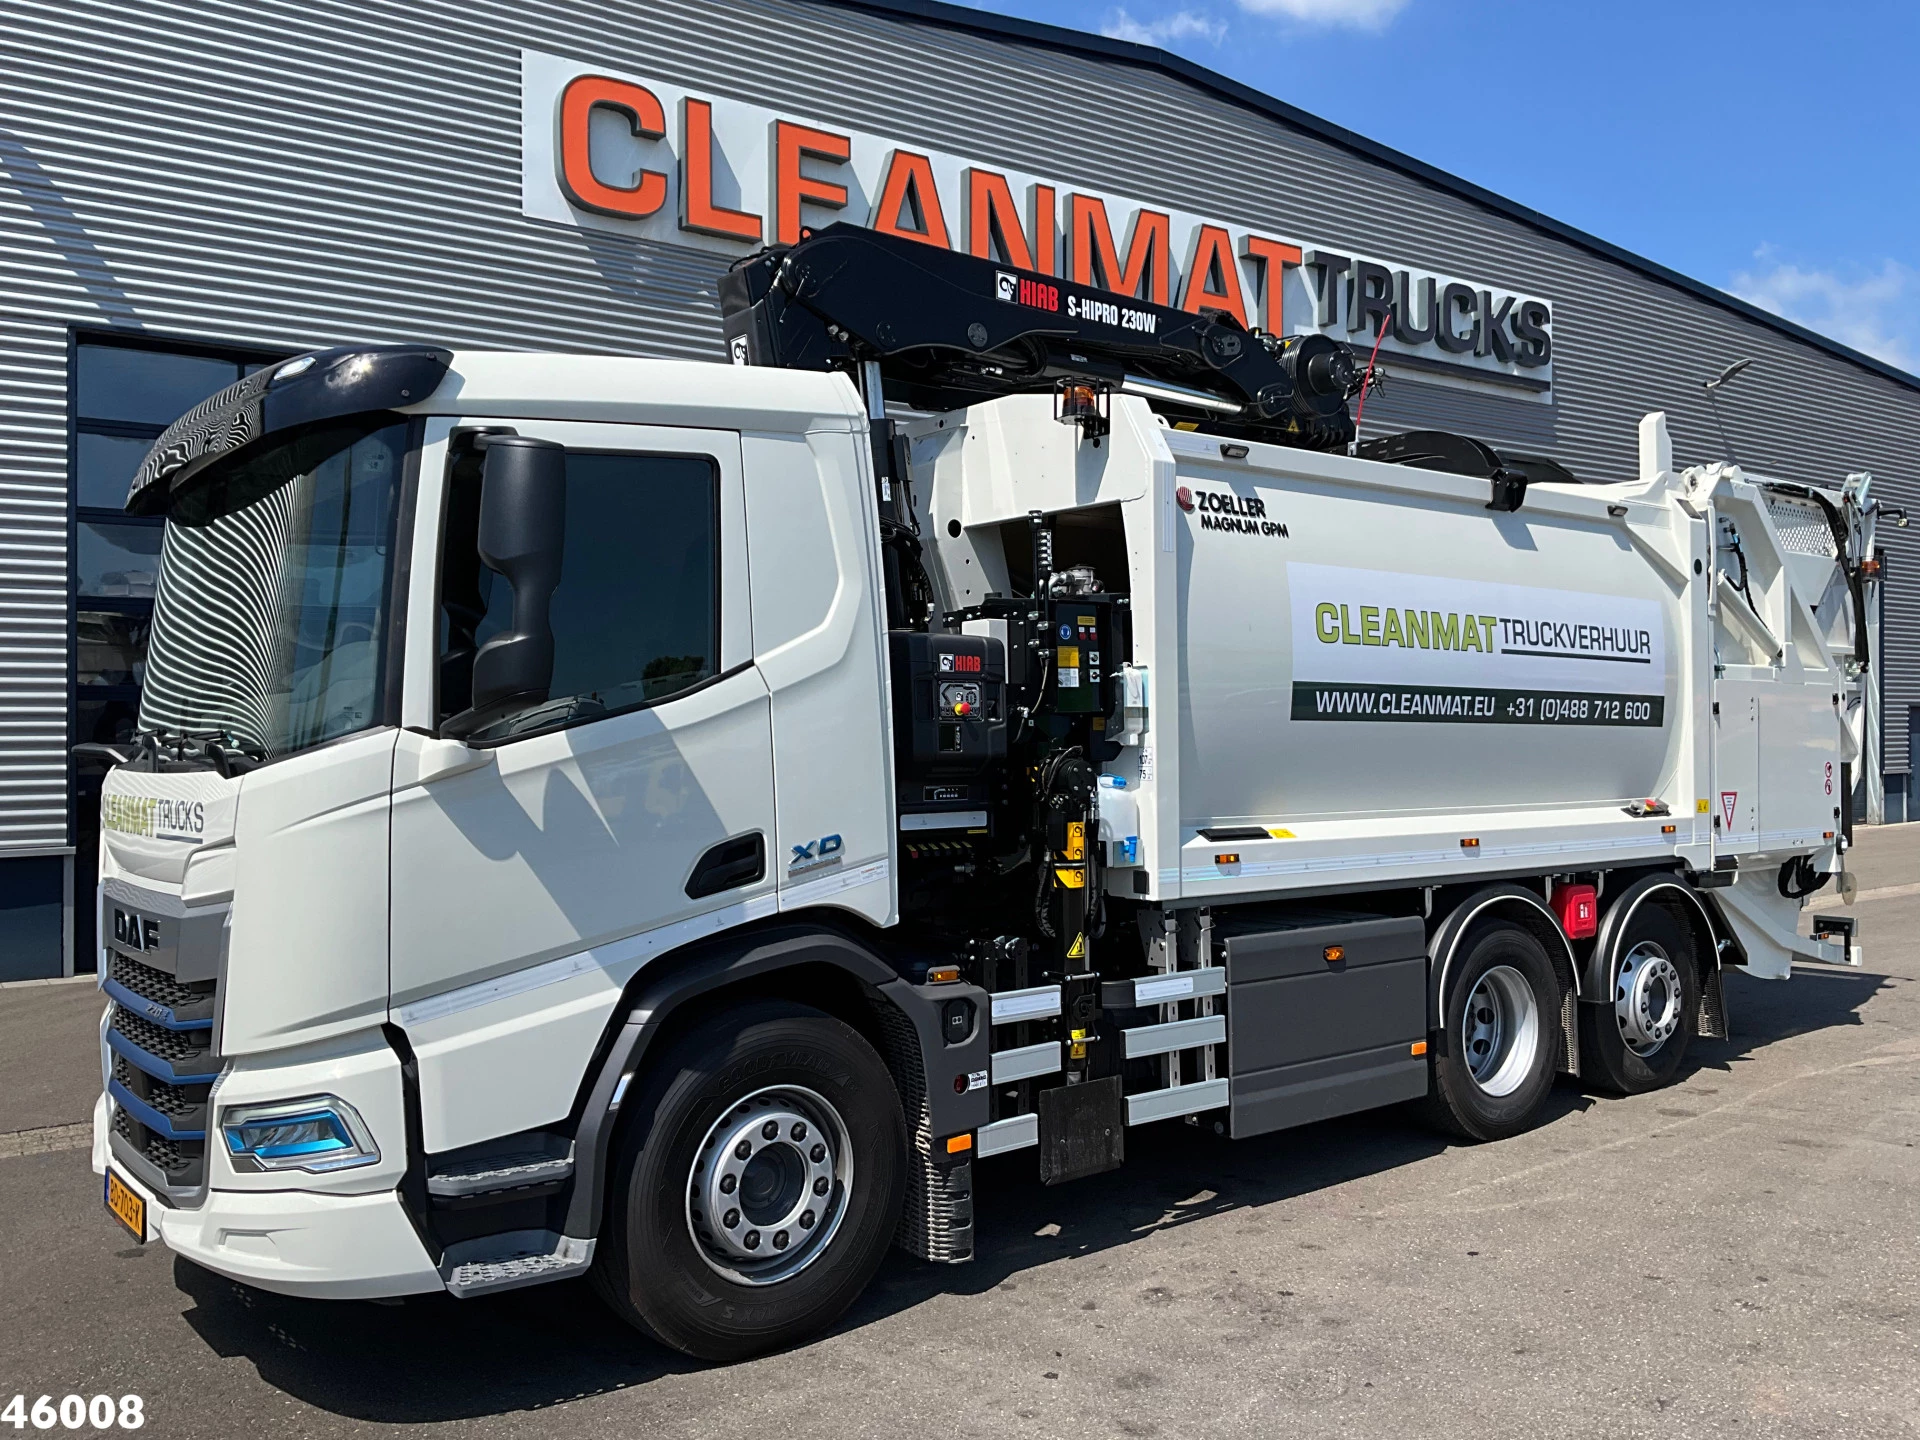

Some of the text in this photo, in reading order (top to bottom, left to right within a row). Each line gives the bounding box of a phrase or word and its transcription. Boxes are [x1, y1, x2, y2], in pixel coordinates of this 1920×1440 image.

[554, 74, 1551, 368] CLEANMAT TRUCKS
[1020, 278, 1157, 334] HIAB S-HIPRO 230W
[1195, 490, 1267, 519] ZOELLER
[1200, 513, 1290, 539] MAGNUM GPM
[1315, 602, 1651, 655] CLEANMAT TRUCKVERHUUR
[955, 655, 981, 672] HIAB
[1315, 690, 1650, 721] WWW.CLEANMAT.EU +31 (0)488 712 600
[158, 799, 204, 833] TRUCKS
[788, 833, 842, 865] XD
[114, 908, 161, 955] DAF
